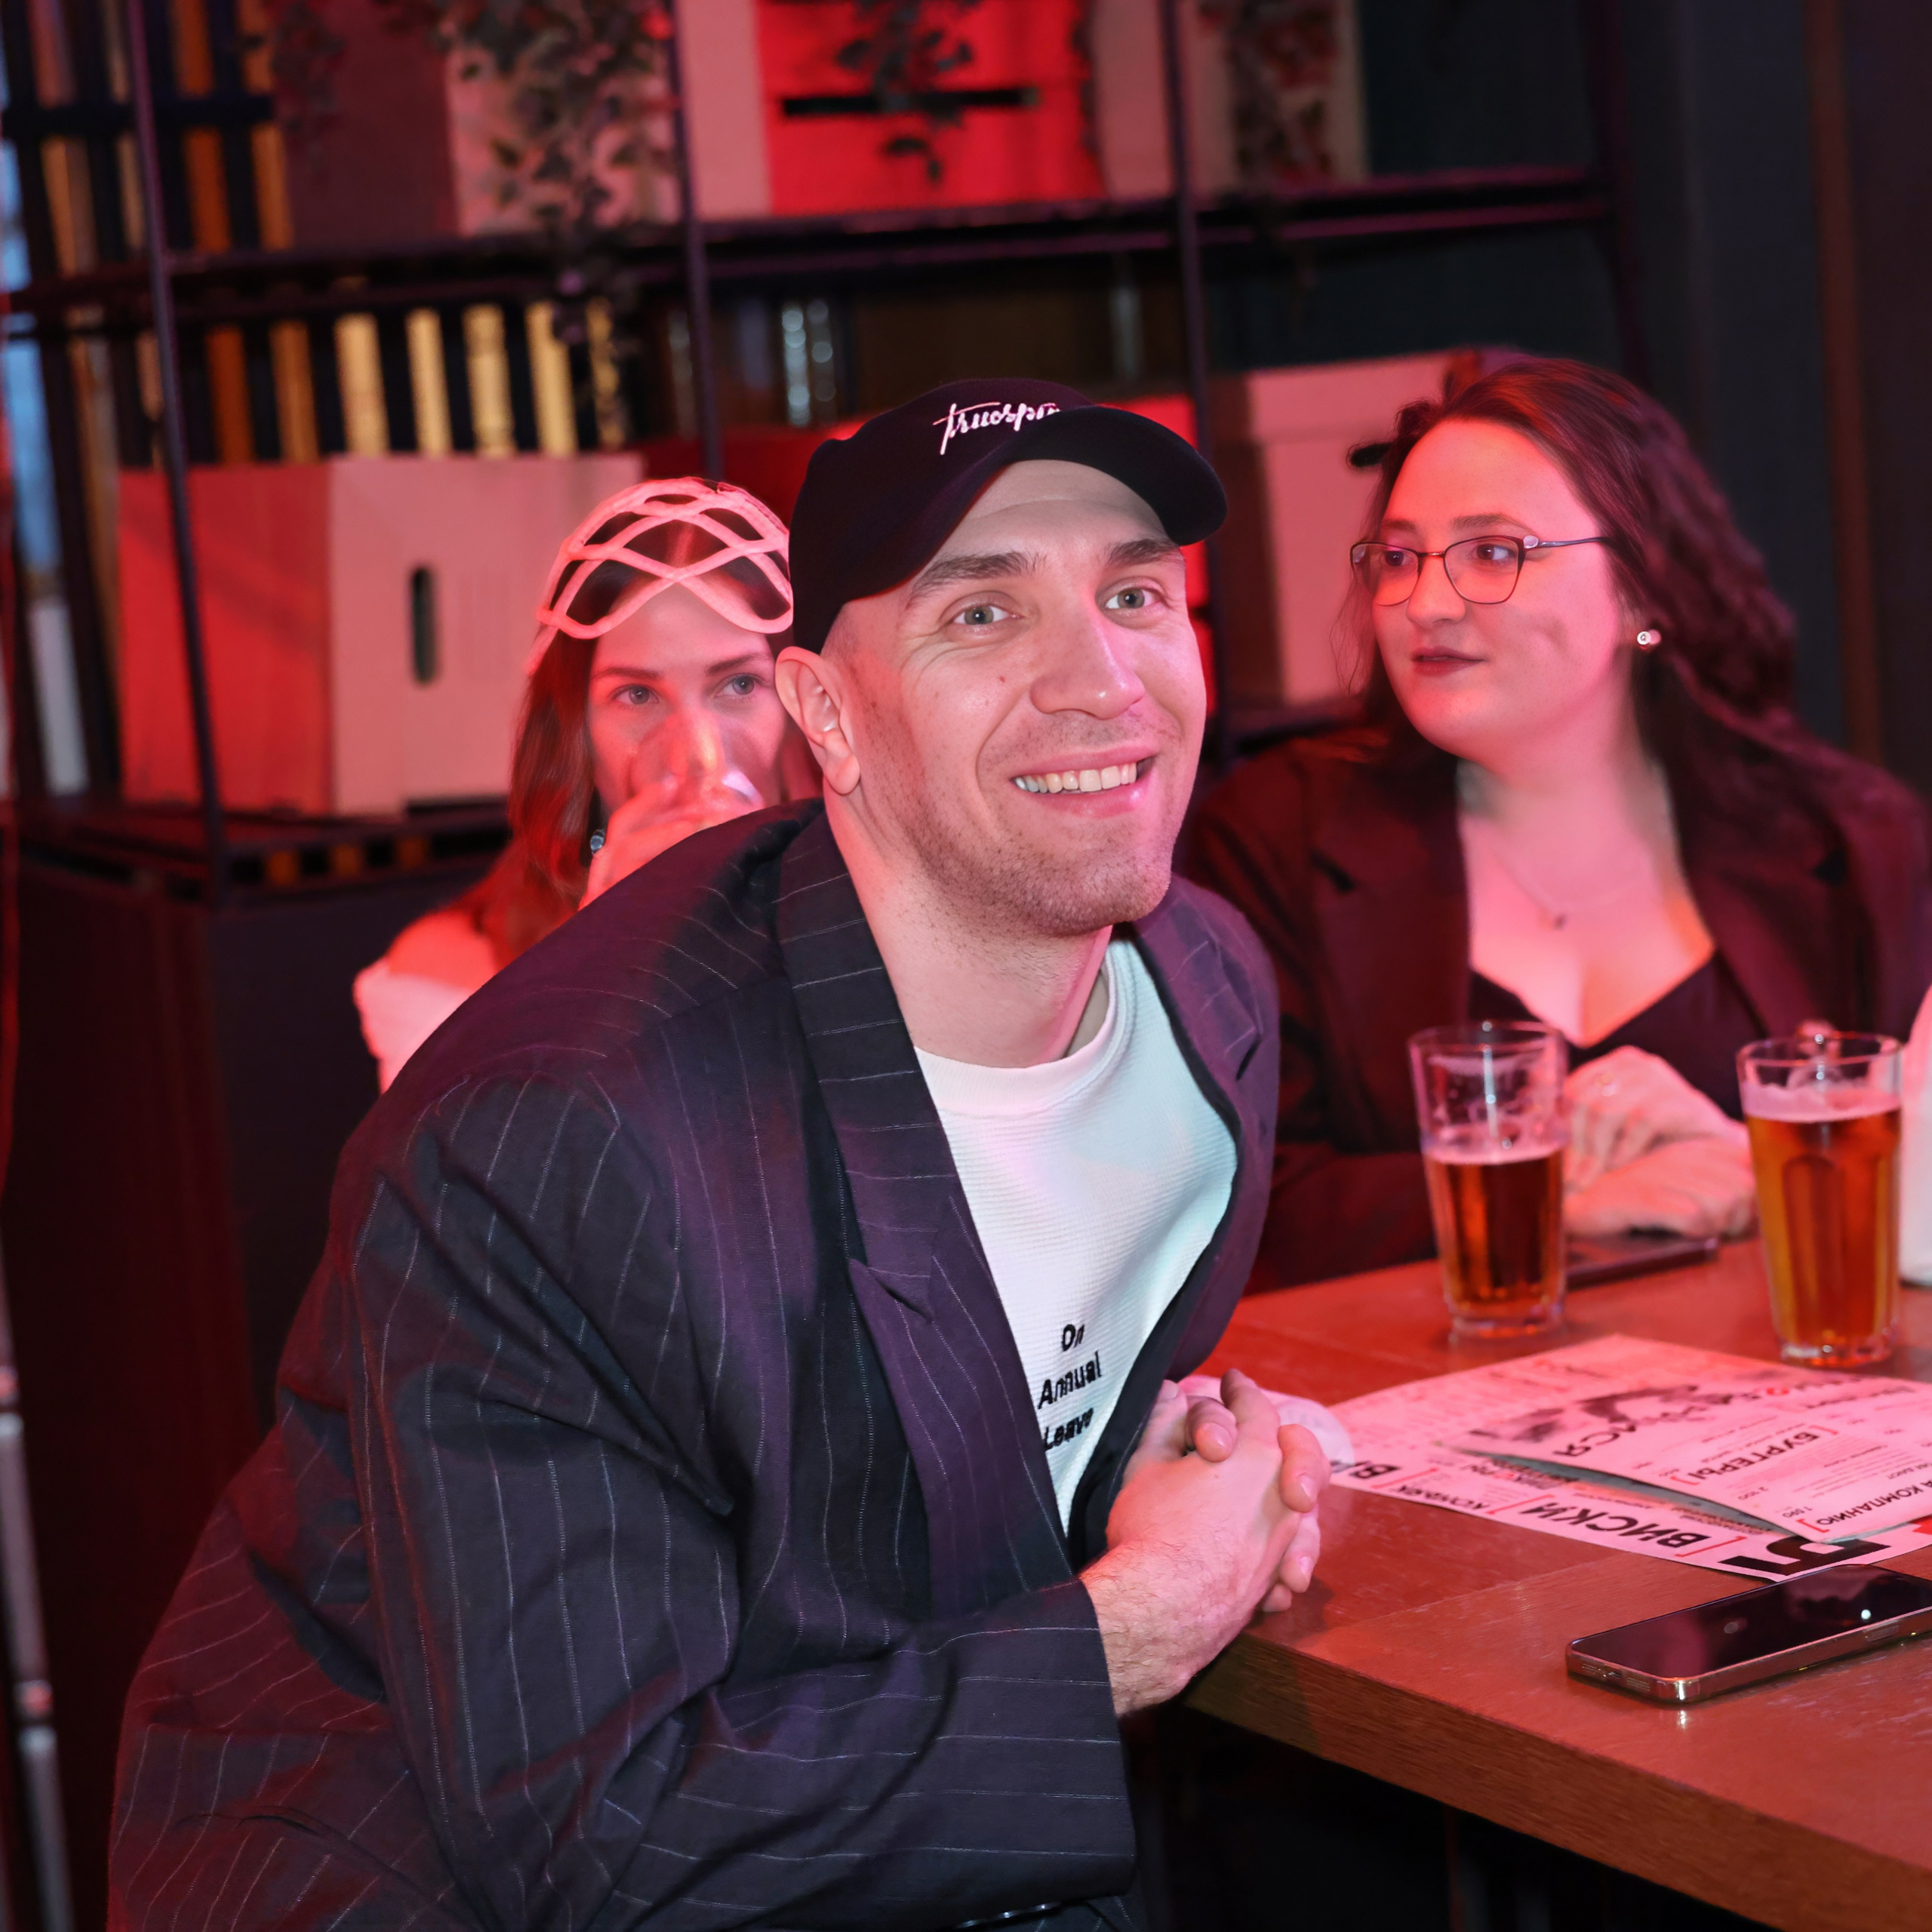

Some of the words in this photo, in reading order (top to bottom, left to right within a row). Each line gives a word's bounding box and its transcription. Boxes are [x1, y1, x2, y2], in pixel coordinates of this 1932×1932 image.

[1062, 1324, 1085, 1352] On
[1037, 1349, 1103, 1410] Annual
[1044, 1407, 1094, 1451] Leave
[1688, 1431, 1820, 1480] БУРГЕРЫ
[1518, 1503, 1712, 1548] ВИСКИ
[1816, 1484, 1924, 1527] КОМПАНИЮ
